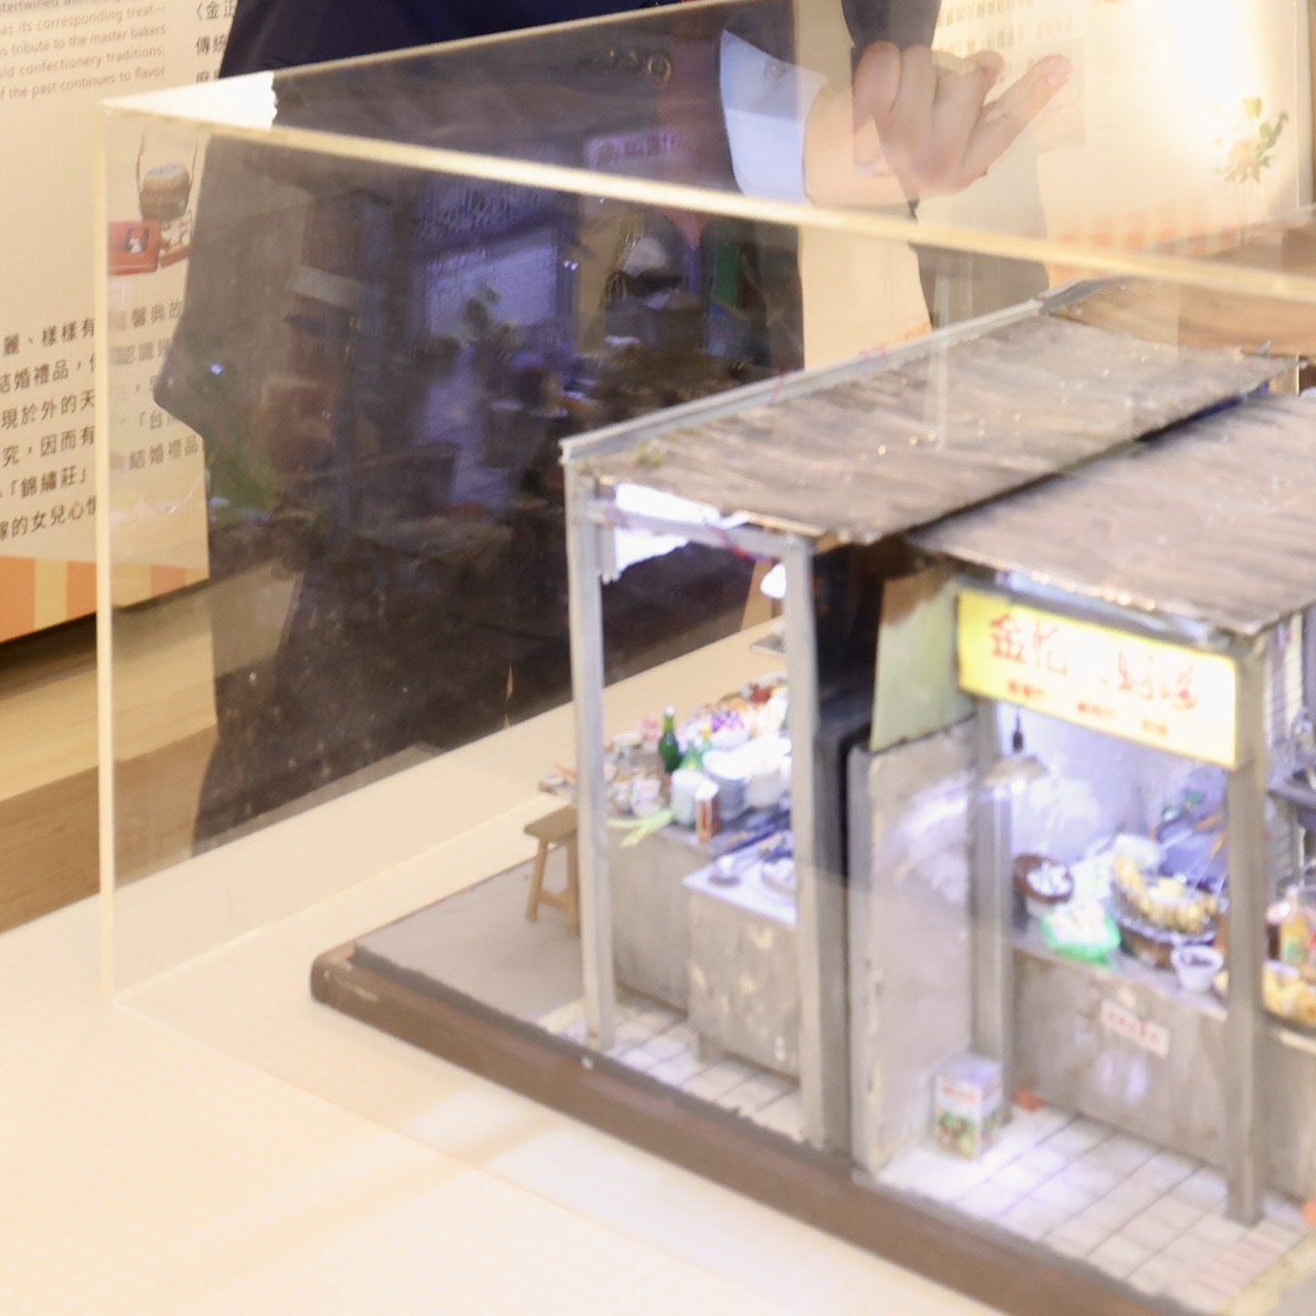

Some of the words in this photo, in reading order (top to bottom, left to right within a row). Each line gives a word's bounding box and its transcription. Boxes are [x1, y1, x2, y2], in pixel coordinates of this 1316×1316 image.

[18, 20, 32, 33] its
[37, 10, 123, 30] corresponding
[12, 40, 50, 55] tribute
[53, 38, 65, 49] to
[69, 34, 87, 47] the
[90, 29, 127, 44] master
[130, 24, 166, 40] bakers
[19, 54, 102, 75] confectionery
[8, 86, 28, 100] the
[31, 81, 57, 98] past
[60, 73, 116, 91] continues
[119, 71, 131, 83] to
[134, 66, 165, 80] flavor
